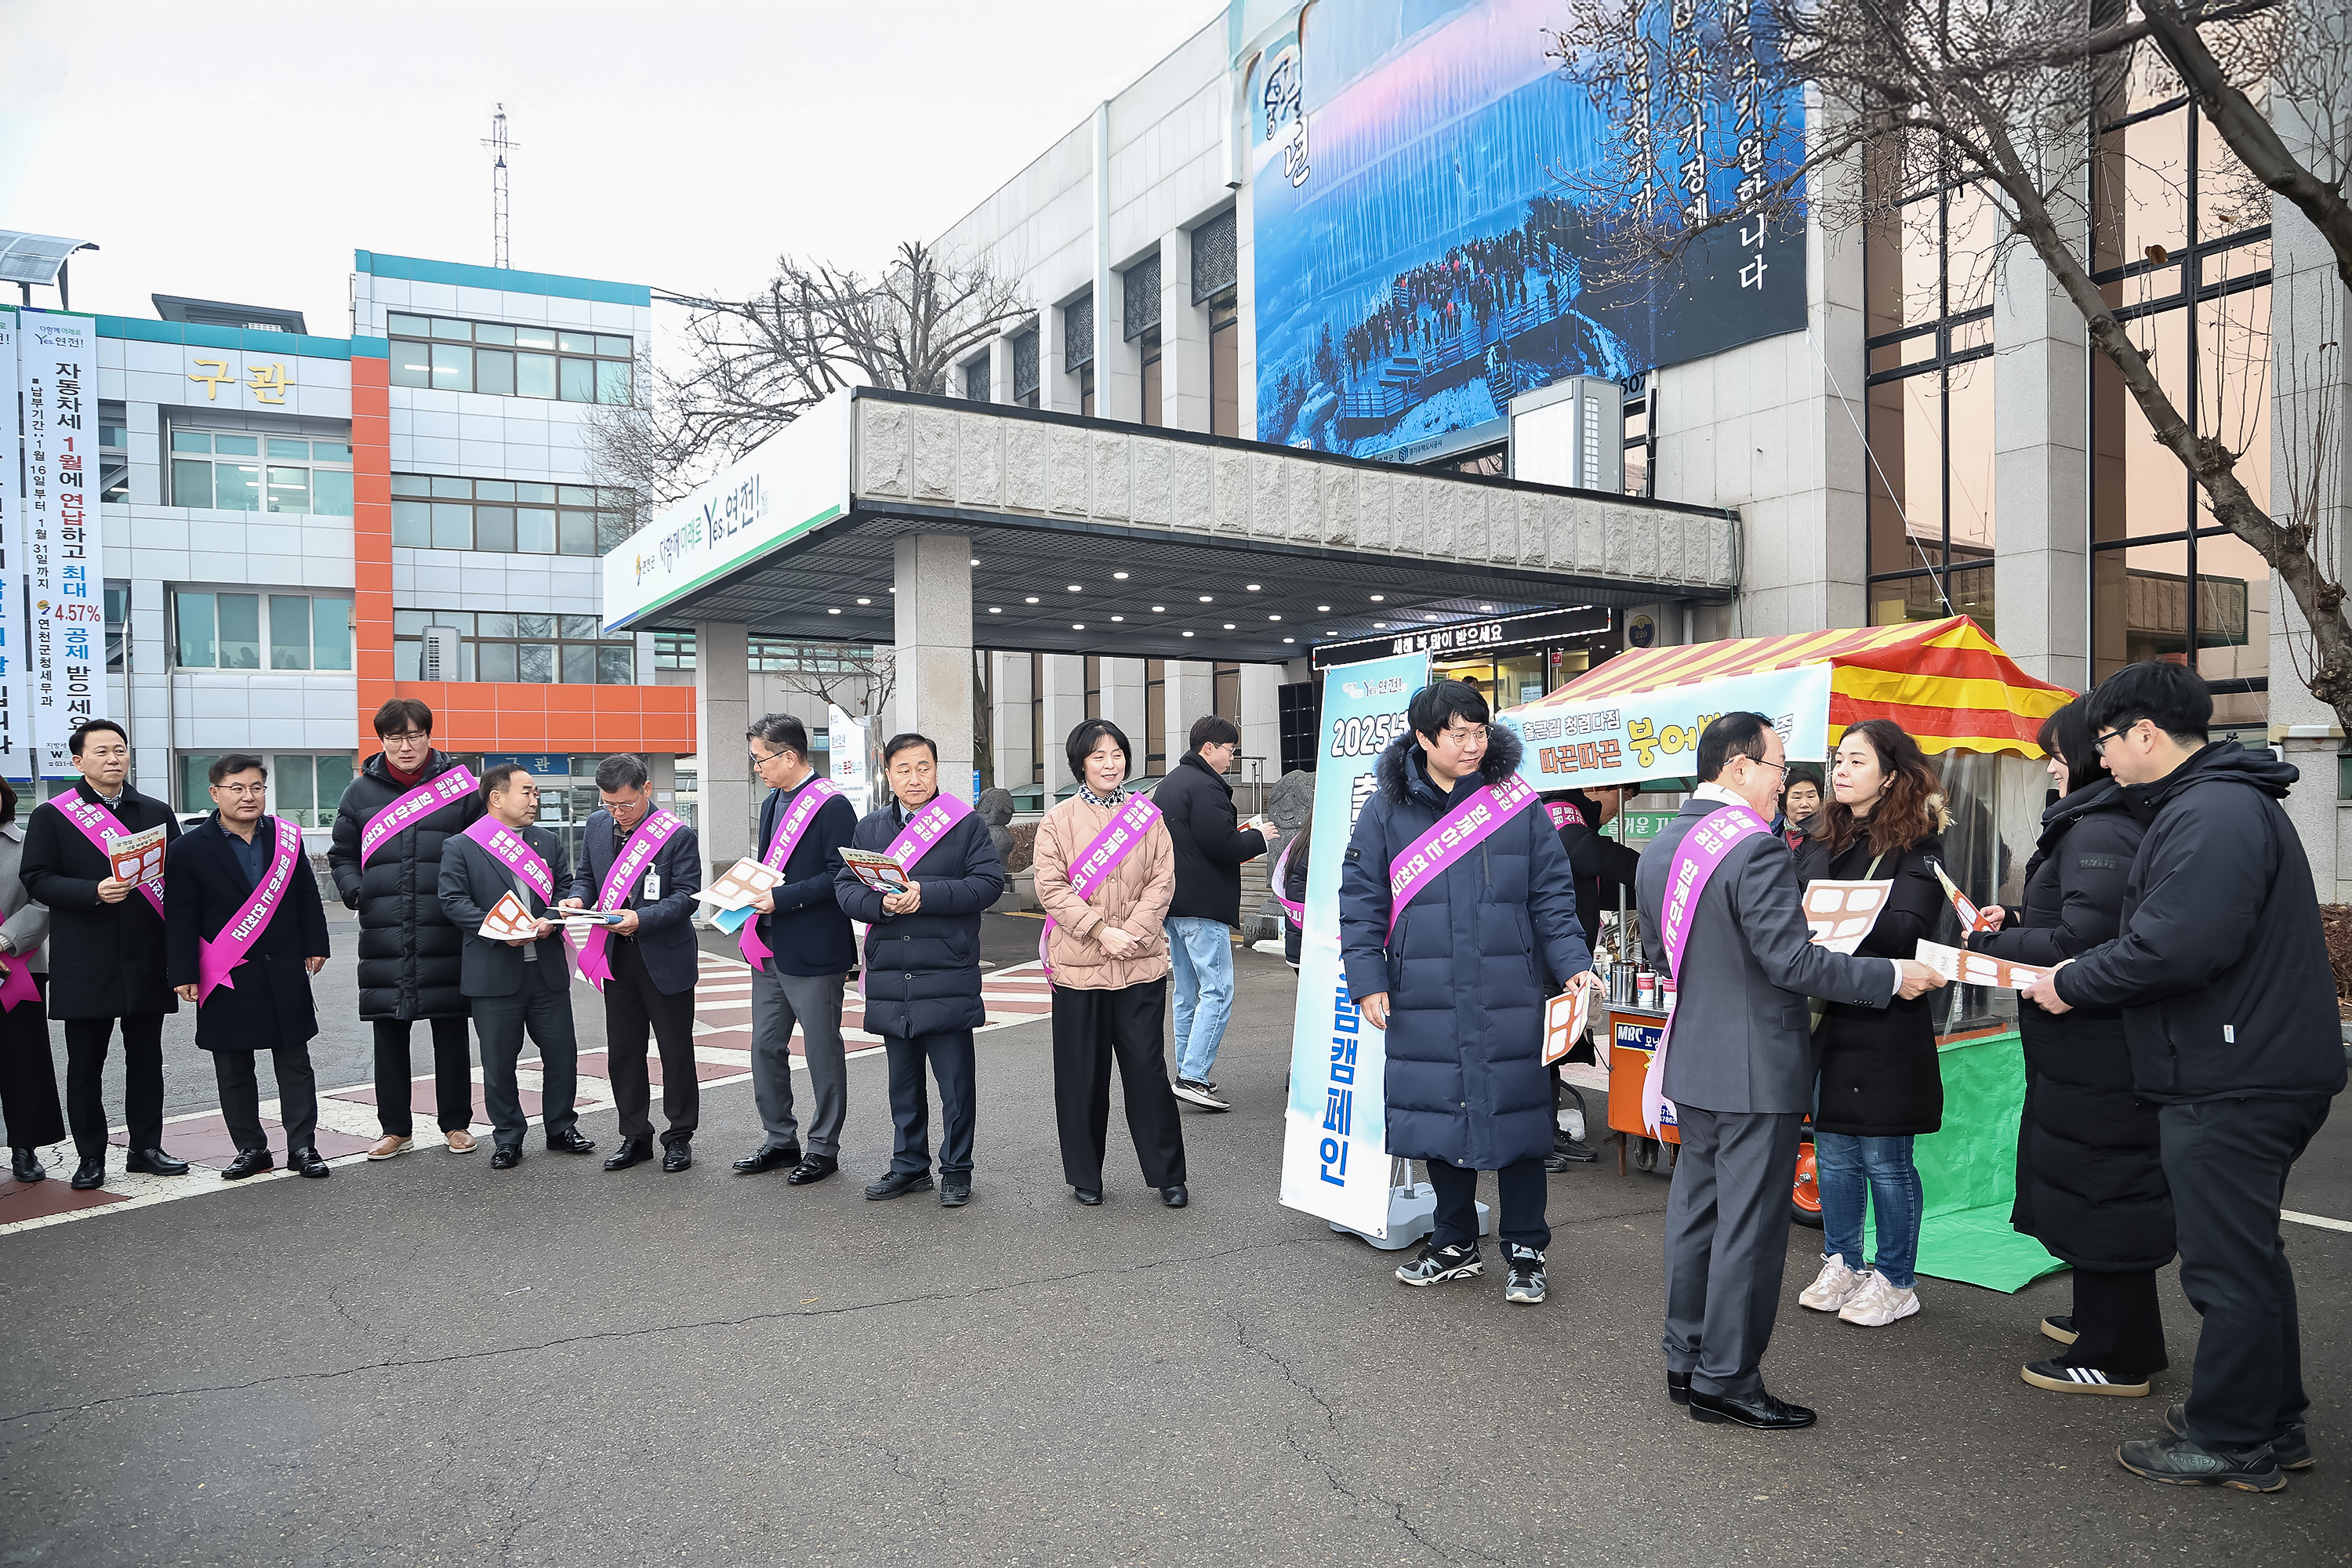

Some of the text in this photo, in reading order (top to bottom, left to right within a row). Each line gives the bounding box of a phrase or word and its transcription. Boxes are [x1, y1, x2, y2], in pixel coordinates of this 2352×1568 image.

[187, 358, 296, 405] 구관
[1409, 439, 1443, 456] 경기주택도시공사
[30, 465, 47, 512] 16일부터
[34, 518, 48, 540] 1월
[55, 362, 101, 731] 자동차세 1월에 연납하고 최대 4.57% 공제 받으세요
[33, 544, 49, 590] 31일까지
[1416, 634, 1428, 651] 복
[1431, 630, 1453, 650] 많이
[1456, 624, 1503, 647] 받으세요
[1635, 630, 1648, 639] 220
[1523, 718, 1562, 742] 출근길
[1539, 739, 1622, 774] 따끈따끈
[383, 791, 435, 829] 함께하는
[779, 794, 816, 848] 함께하는
[1424, 803, 1493, 862] 함께하는
[1607, 817, 1650, 834] 즐거운
[612, 839, 652, 890] 함께하는
[1080, 826, 1130, 878] 함께하는
[230, 854, 291, 942] 함께하는 연천군
[522, 859, 553, 901] 함께하
[1665, 857, 1700, 947] 함께하는
[1617, 1025, 1643, 1043] MBC
[1319, 955, 1361, 1188] 렴캠페인
